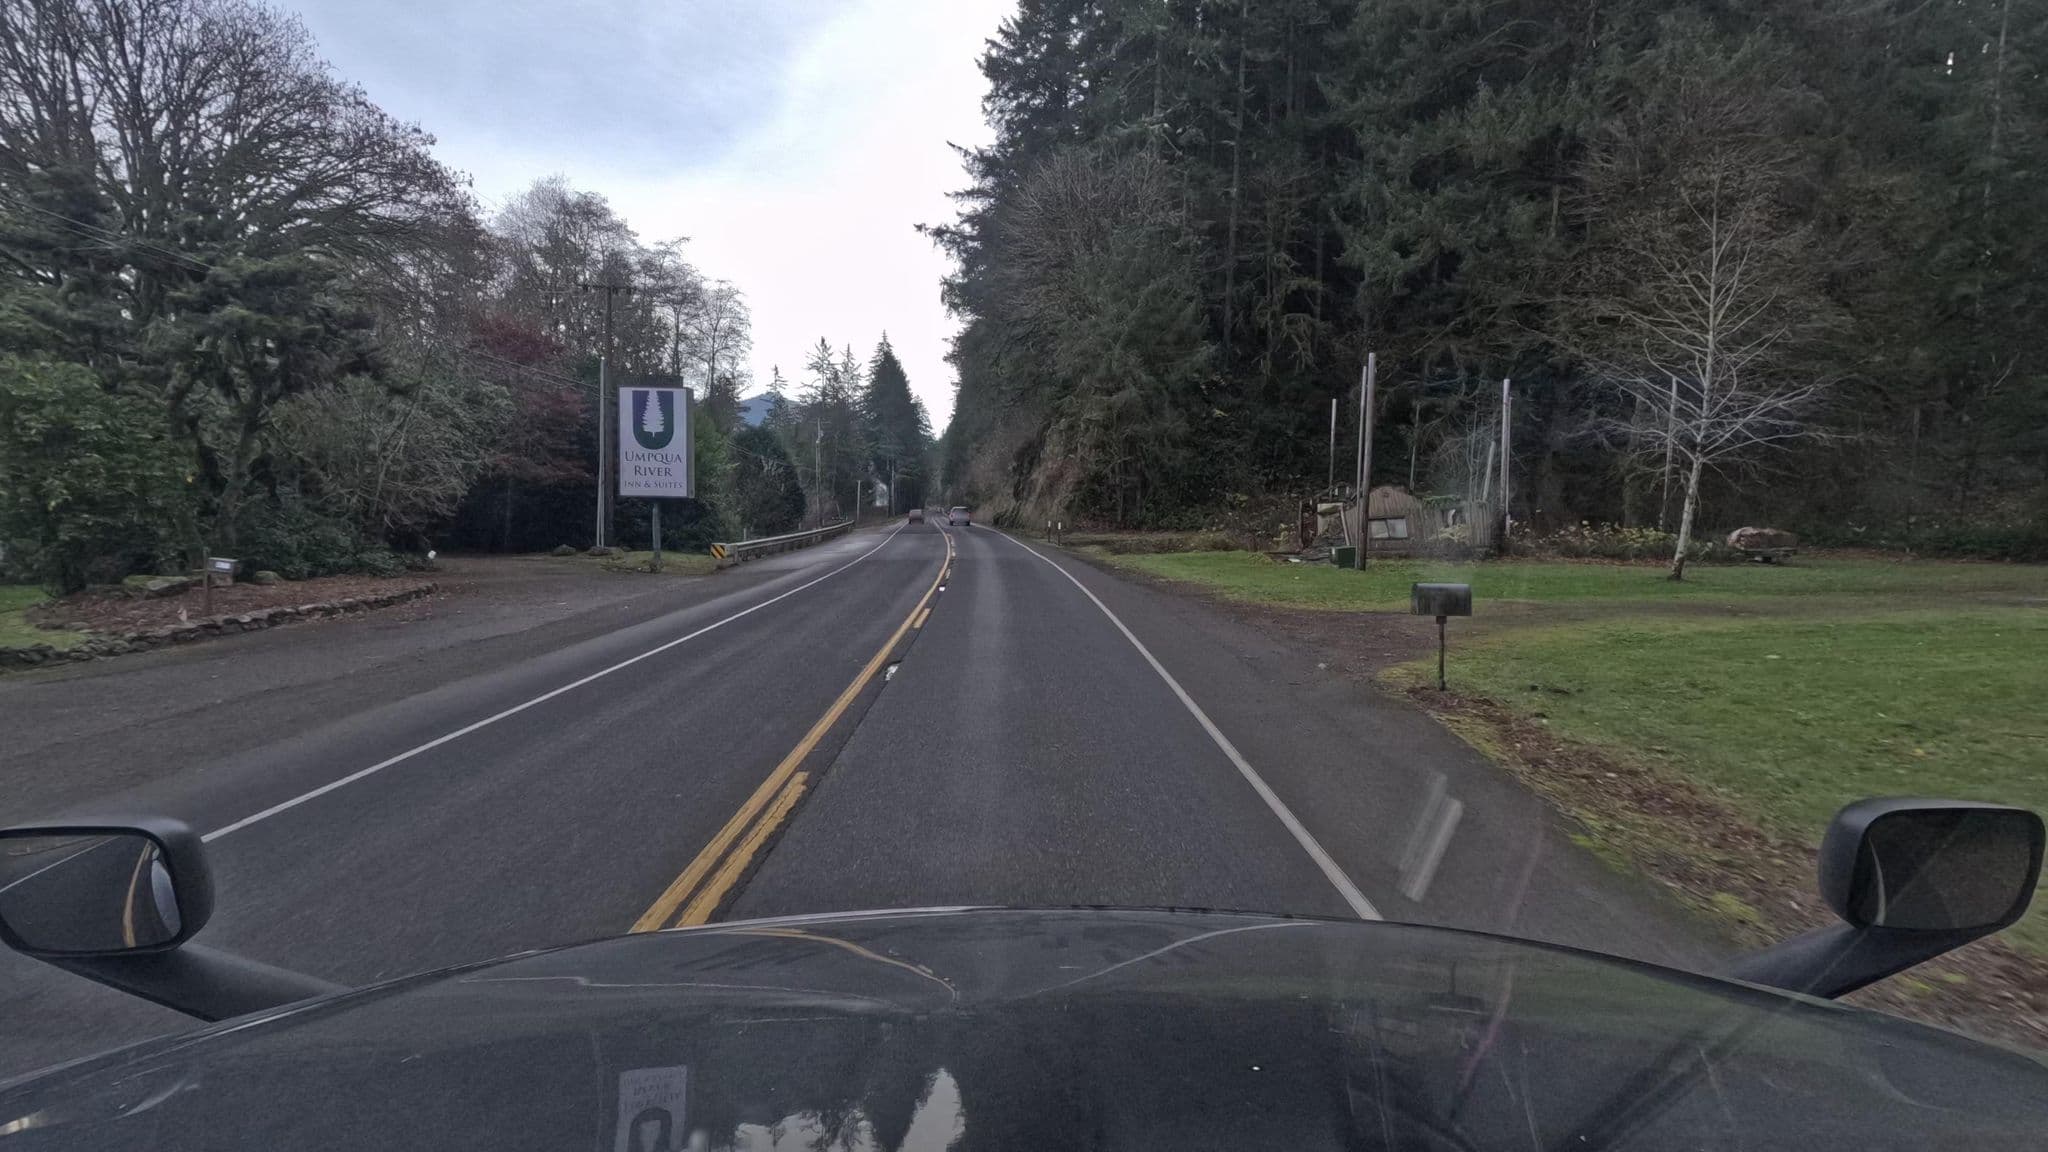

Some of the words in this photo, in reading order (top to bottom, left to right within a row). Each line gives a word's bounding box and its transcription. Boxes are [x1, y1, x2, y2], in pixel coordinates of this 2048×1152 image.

[625, 451, 682, 465] UMPQUA
[634, 465, 673, 477] RIVER
[624, 480, 641, 488] INN
[643, 480, 651, 488] &
[654, 480, 683, 489] SUITES
